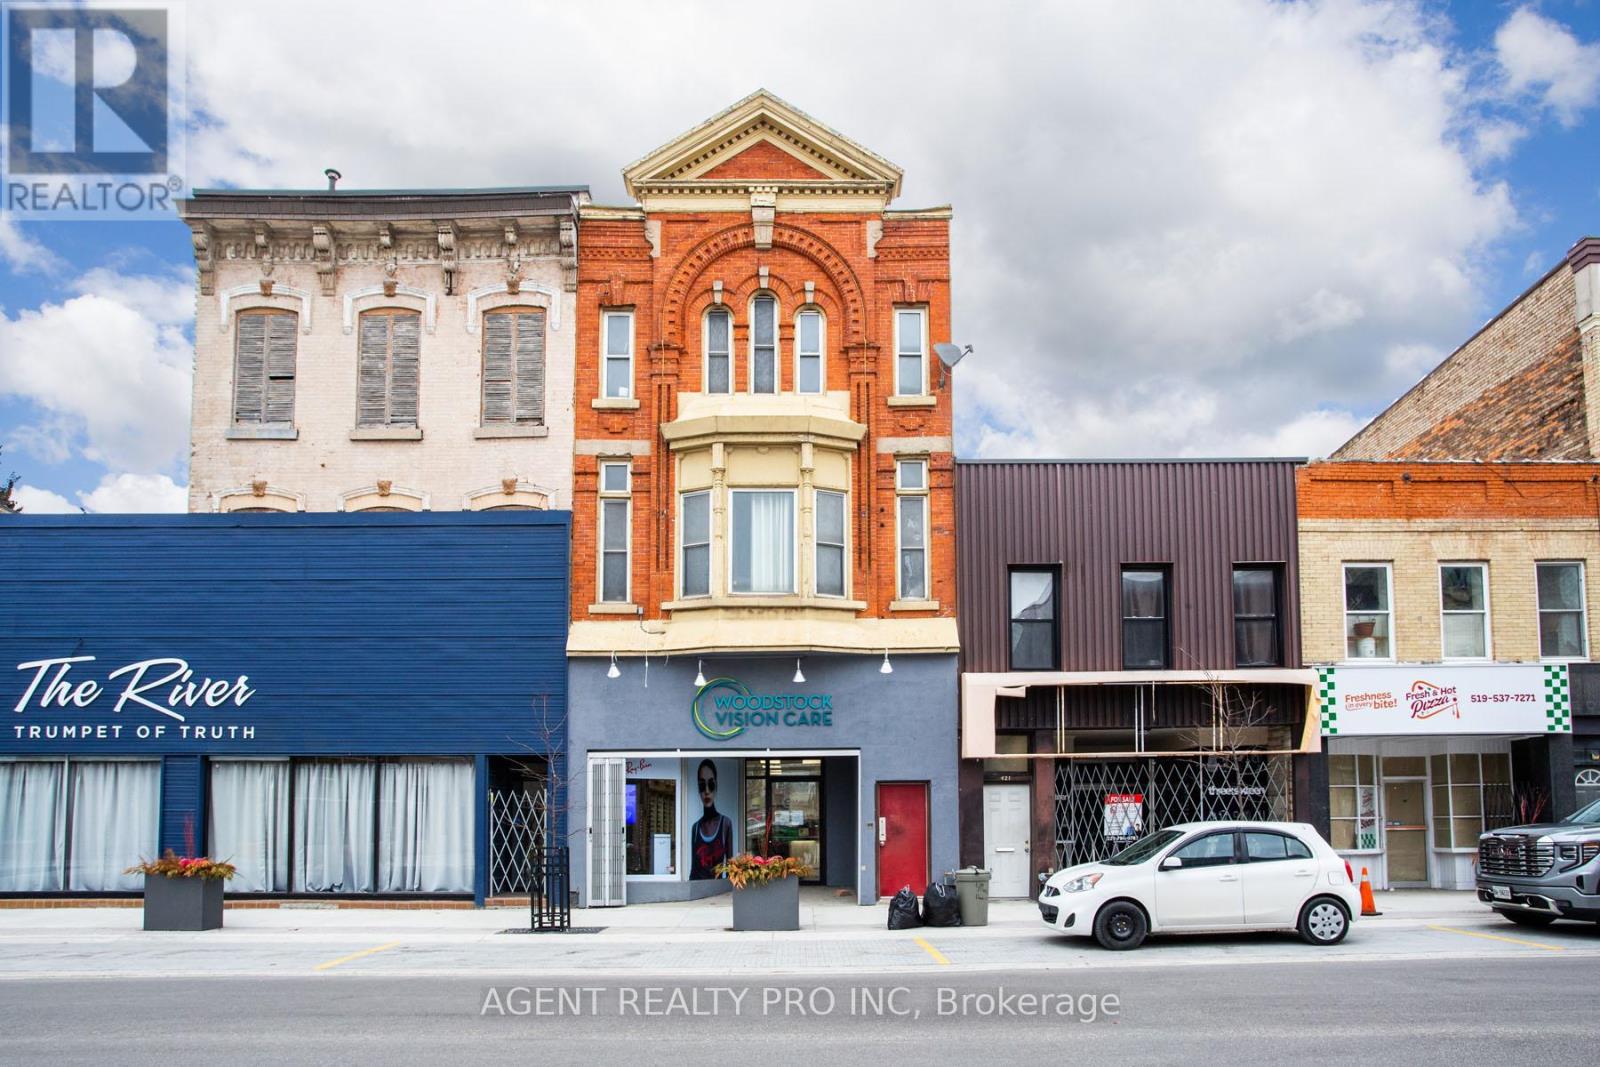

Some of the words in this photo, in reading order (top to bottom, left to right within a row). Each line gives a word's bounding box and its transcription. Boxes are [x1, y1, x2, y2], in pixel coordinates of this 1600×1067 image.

[14, 656, 103, 712] The
[108, 657, 256, 721] River
[1405, 689, 1430, 701] Fresh
[1432, 689, 1438, 697] &
[1440, 686, 1457, 696] Hot
[713, 693, 833, 711] WOODSTOCK
[1345, 691, 1392, 703] Freshness
[1373, 698, 1398, 710] bite!
[1470, 694, 1537, 703] 519-537-7271
[715, 711, 780, 727] VISION
[783, 711, 833, 727] CARE
[14, 725, 123, 739] TRUMPET
[136, 725, 166, 739] OF
[180, 726, 256, 739] TRUTH
